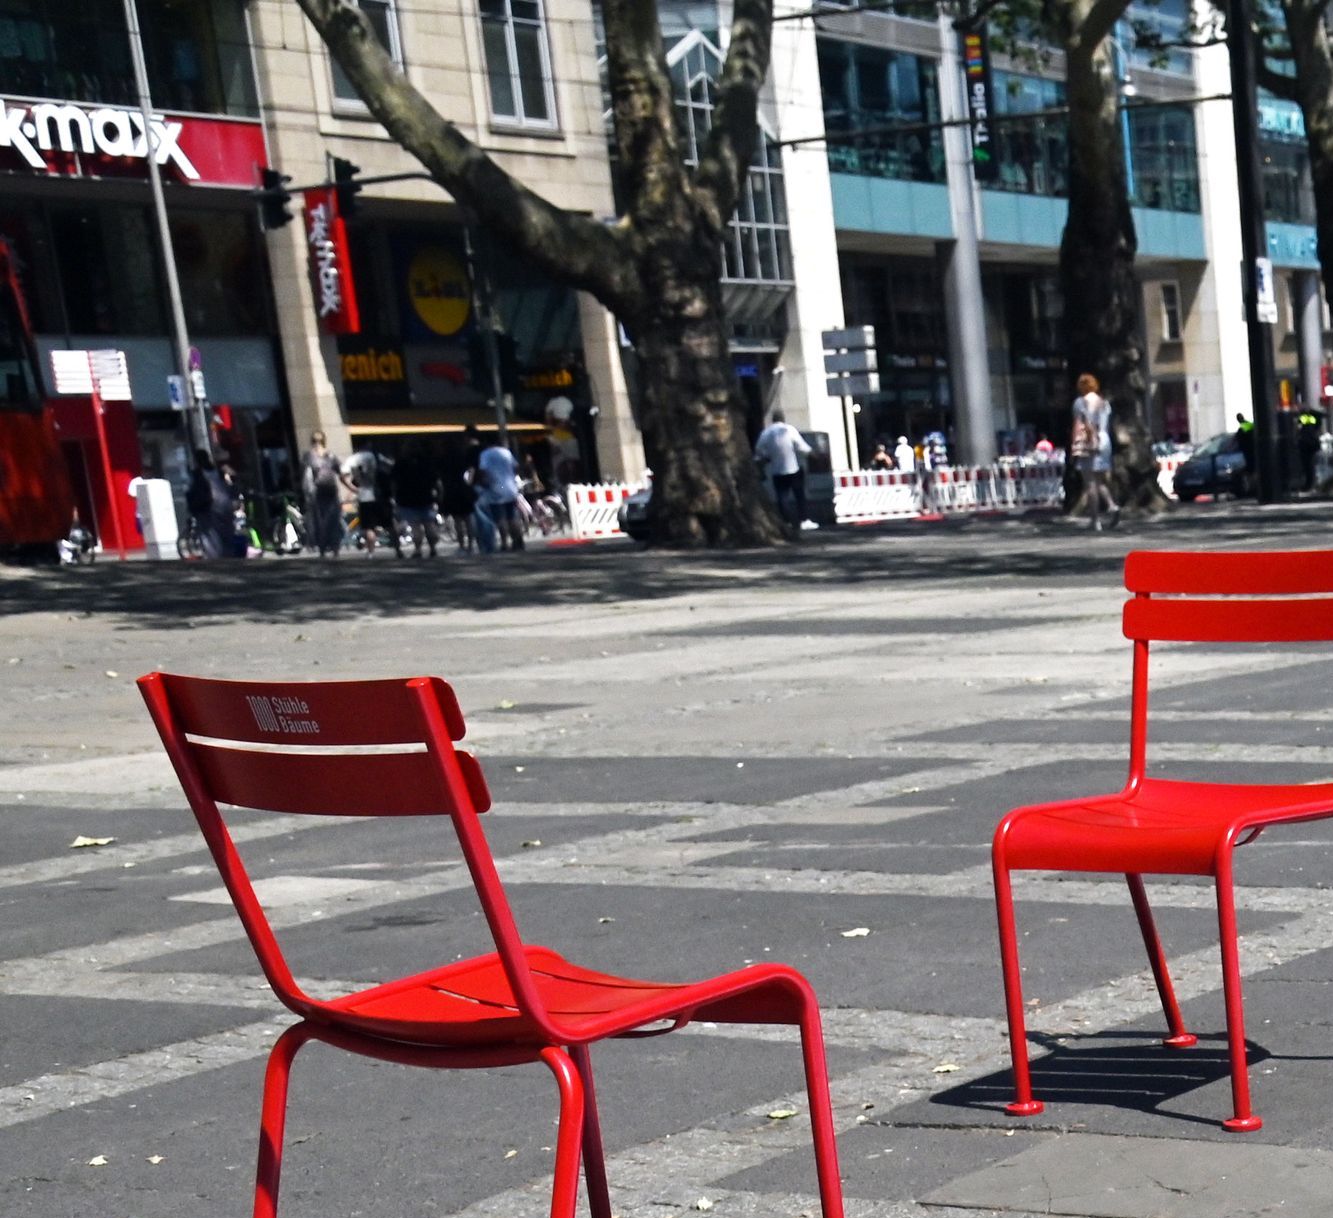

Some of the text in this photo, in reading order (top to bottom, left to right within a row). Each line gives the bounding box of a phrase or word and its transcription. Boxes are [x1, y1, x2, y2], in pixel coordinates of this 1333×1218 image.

[245, 695, 310, 733] 1000 Stühle
[279, 715, 321, 733] Bäume
